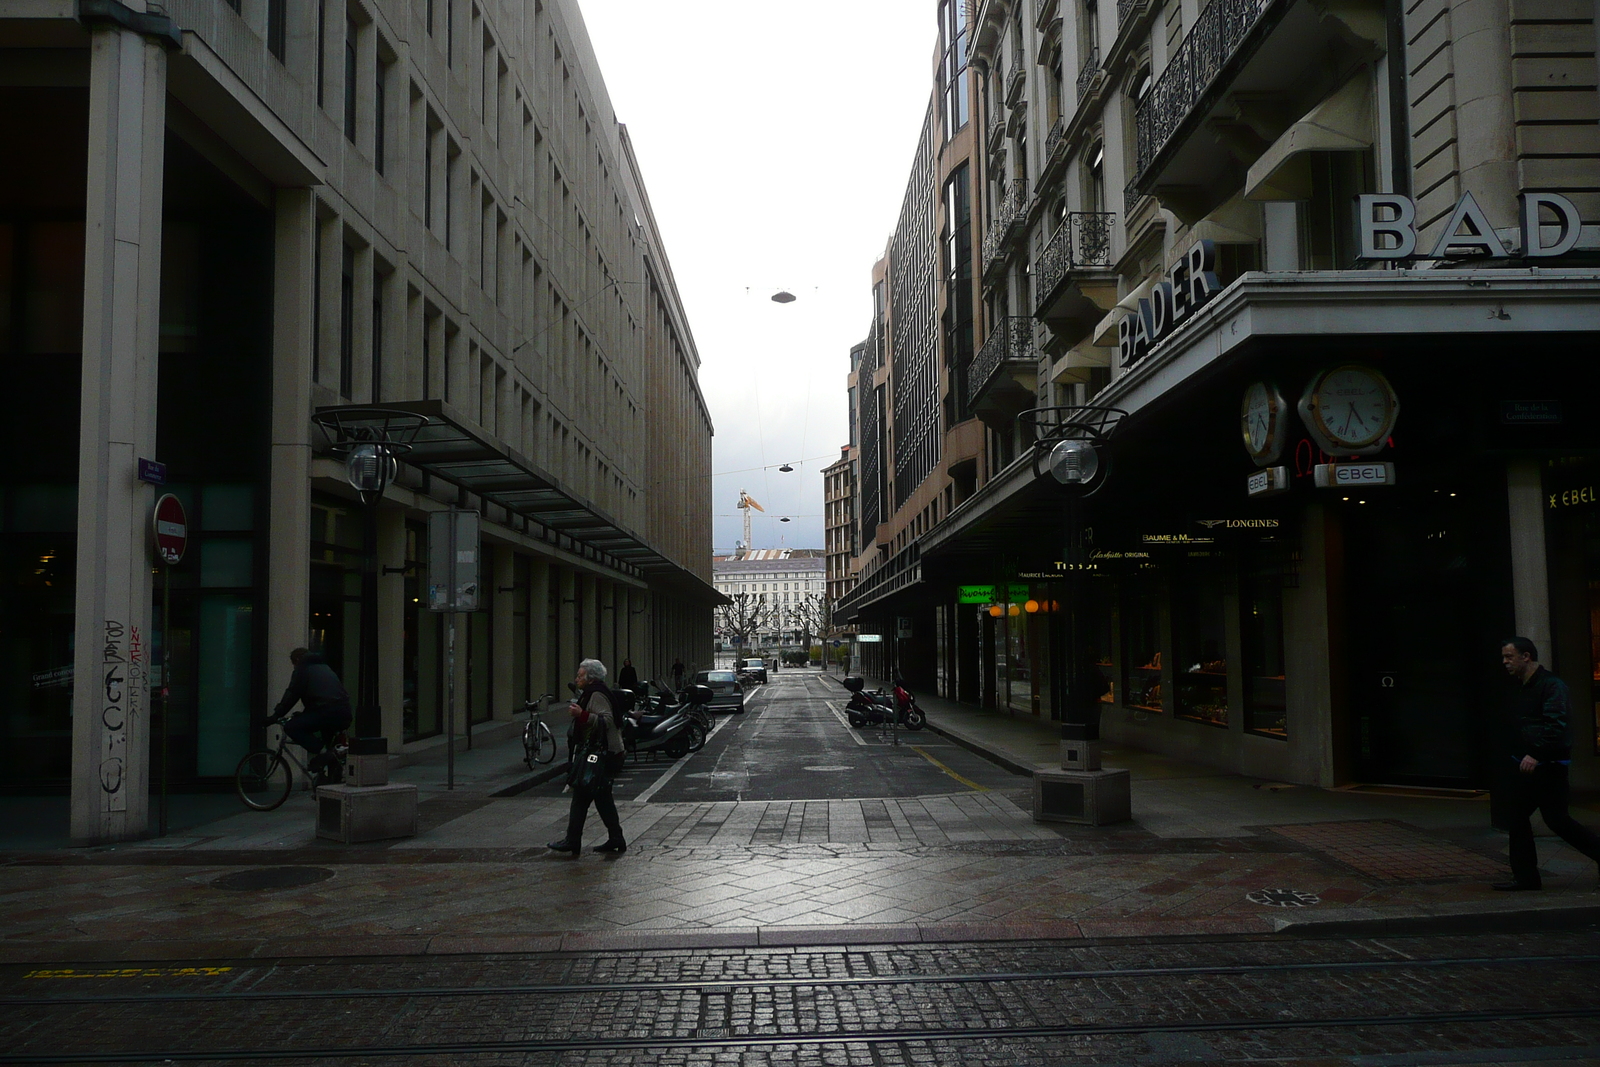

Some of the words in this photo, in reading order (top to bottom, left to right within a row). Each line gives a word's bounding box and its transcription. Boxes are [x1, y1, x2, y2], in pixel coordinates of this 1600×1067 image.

[1355, 191, 1582, 260] BAD
[1117, 239, 1220, 368] BADER
[1514, 403, 1529, 412] Rue
[1530, 403, 1540, 412] de
[1541, 403, 1549, 412] la
[1337, 468, 1386, 480] EBEL
[1249, 479, 1268, 491] EBEL
[1562, 486, 1597, 507] EBEL
[1225, 518, 1280, 529] LONGINES
[1142, 533, 1172, 542] BAUME
[1124, 551, 1151, 559] ORIGINAL
